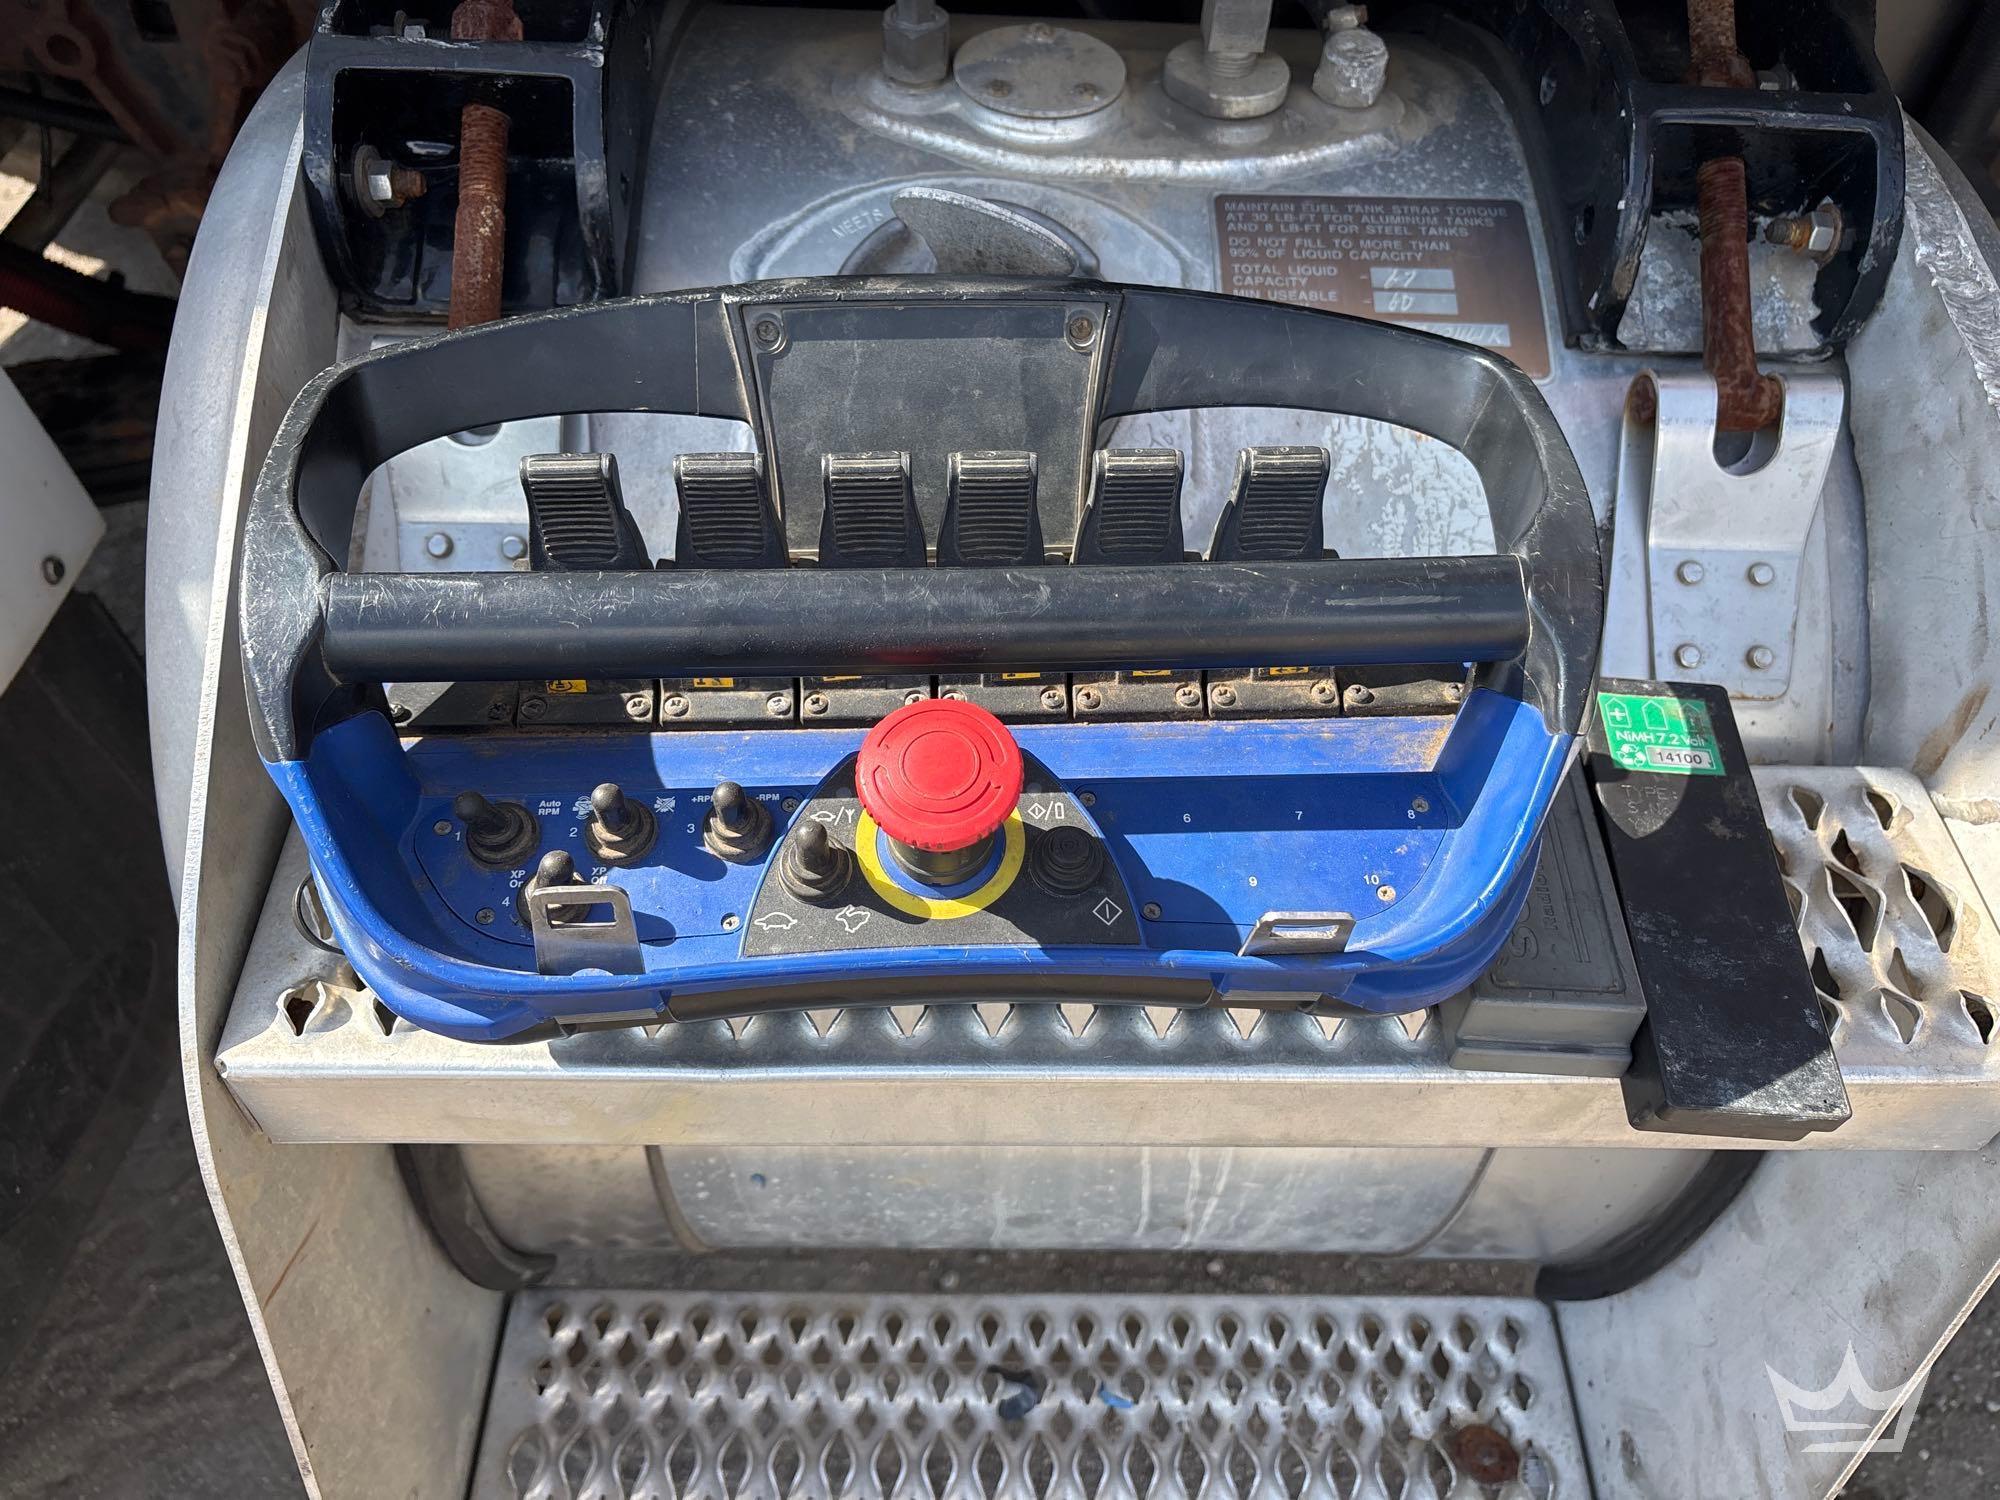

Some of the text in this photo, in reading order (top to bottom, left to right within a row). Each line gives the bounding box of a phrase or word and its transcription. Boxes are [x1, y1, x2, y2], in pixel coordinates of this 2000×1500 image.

[1224, 202, 1508, 217] MAINTAIN FUEL TANK STRAP TORQUE
[830, 208, 884, 240] MEETS
[1226, 212, 1495, 228] AT 30 LB-FT FOR ALUMINUM TANKS
[1227, 223, 1258, 232] AND
[1281, 224, 1321, 233] LB-FT
[1329, 224, 1360, 234] FOR
[1365, 225, 1412, 236] STEEL
[1419, 226, 1470, 238] TANKS
[1228, 236, 1451, 251] DO NOT FILL TO MORE THAN
[1265, 248, 1286, 258] OF
[1293, 248, 1342, 260] LIQUID
[1349, 250, 1424, 261] CAPACITY
[1231, 263, 1338, 277] TOTAL LIQUID
[1232, 275, 1309, 287] CAPACITY
[1267, 289, 1338, 302] USEABLE
[1615, 730, 1655, 744] NiMH
[1658, 732, 1680, 745] 7.2
[1656, 752, 1703, 765] 14100
[539, 800, 562, 808] Auto
[538, 808, 560, 816] RPM
[1183, 812, 1192, 824] 6
[1294, 810, 1303, 821] 7
[1407, 809, 1416, 820] 8
[569, 827, 579, 838] 2
[686, 823, 696, 834] 3
[455, 831, 461, 842] 1
[510, 869, 526, 880] XP
[591, 866, 607, 876] XP
[1248, 875, 1258, 887] 9
[1363, 873, 1380, 886] 10
[501, 896, 511, 908] 4
